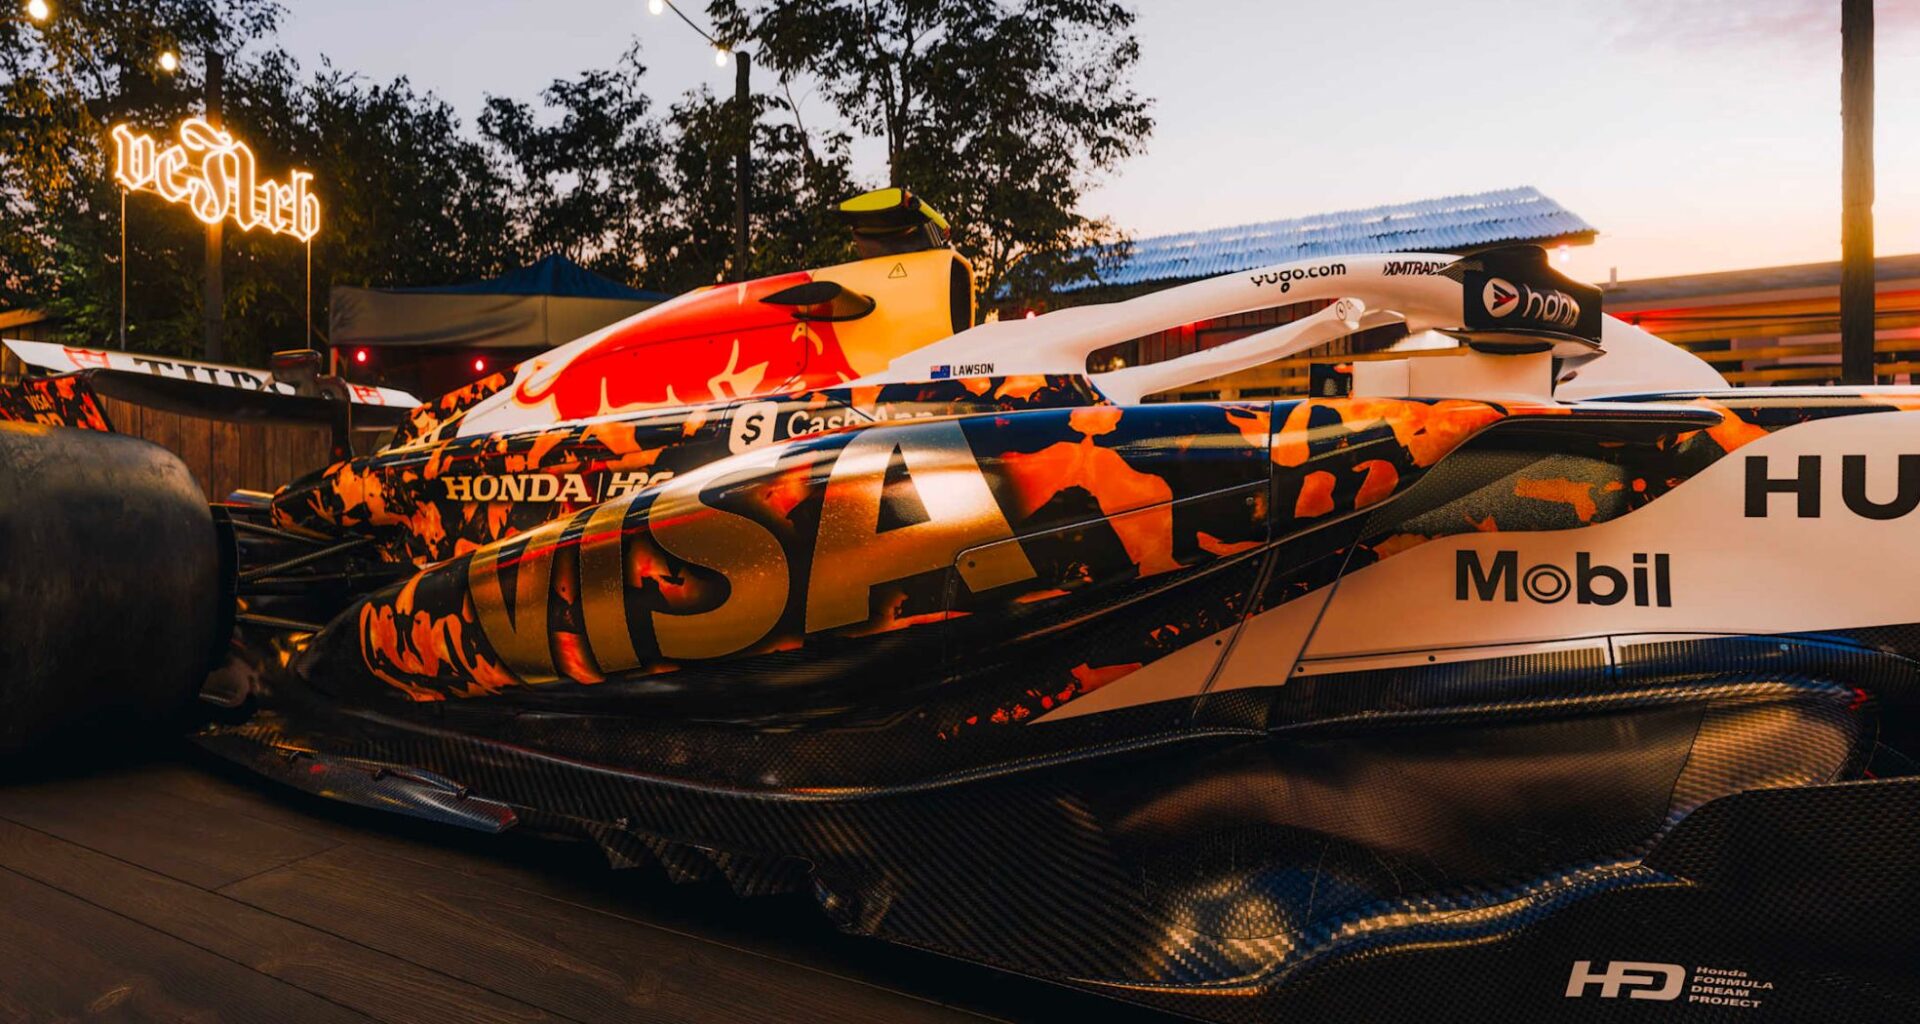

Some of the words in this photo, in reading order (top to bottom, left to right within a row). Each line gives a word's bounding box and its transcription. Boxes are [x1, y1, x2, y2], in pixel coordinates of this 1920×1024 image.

[1250, 263, 1347, 293] yugo.com
[952, 363, 994, 376] LAWSON
[440, 473, 592, 502] HONDA
[1744, 454, 1920, 520] HU
[468, 420, 1037, 684] VISA
[1455, 549, 1672, 608] Mobil
[1693, 975, 1774, 990] FORMULA
[1696, 966, 1747, 978] Honda
[1689, 995, 1762, 1009] PROJECT
[1691, 985, 1750, 997] DREAM
